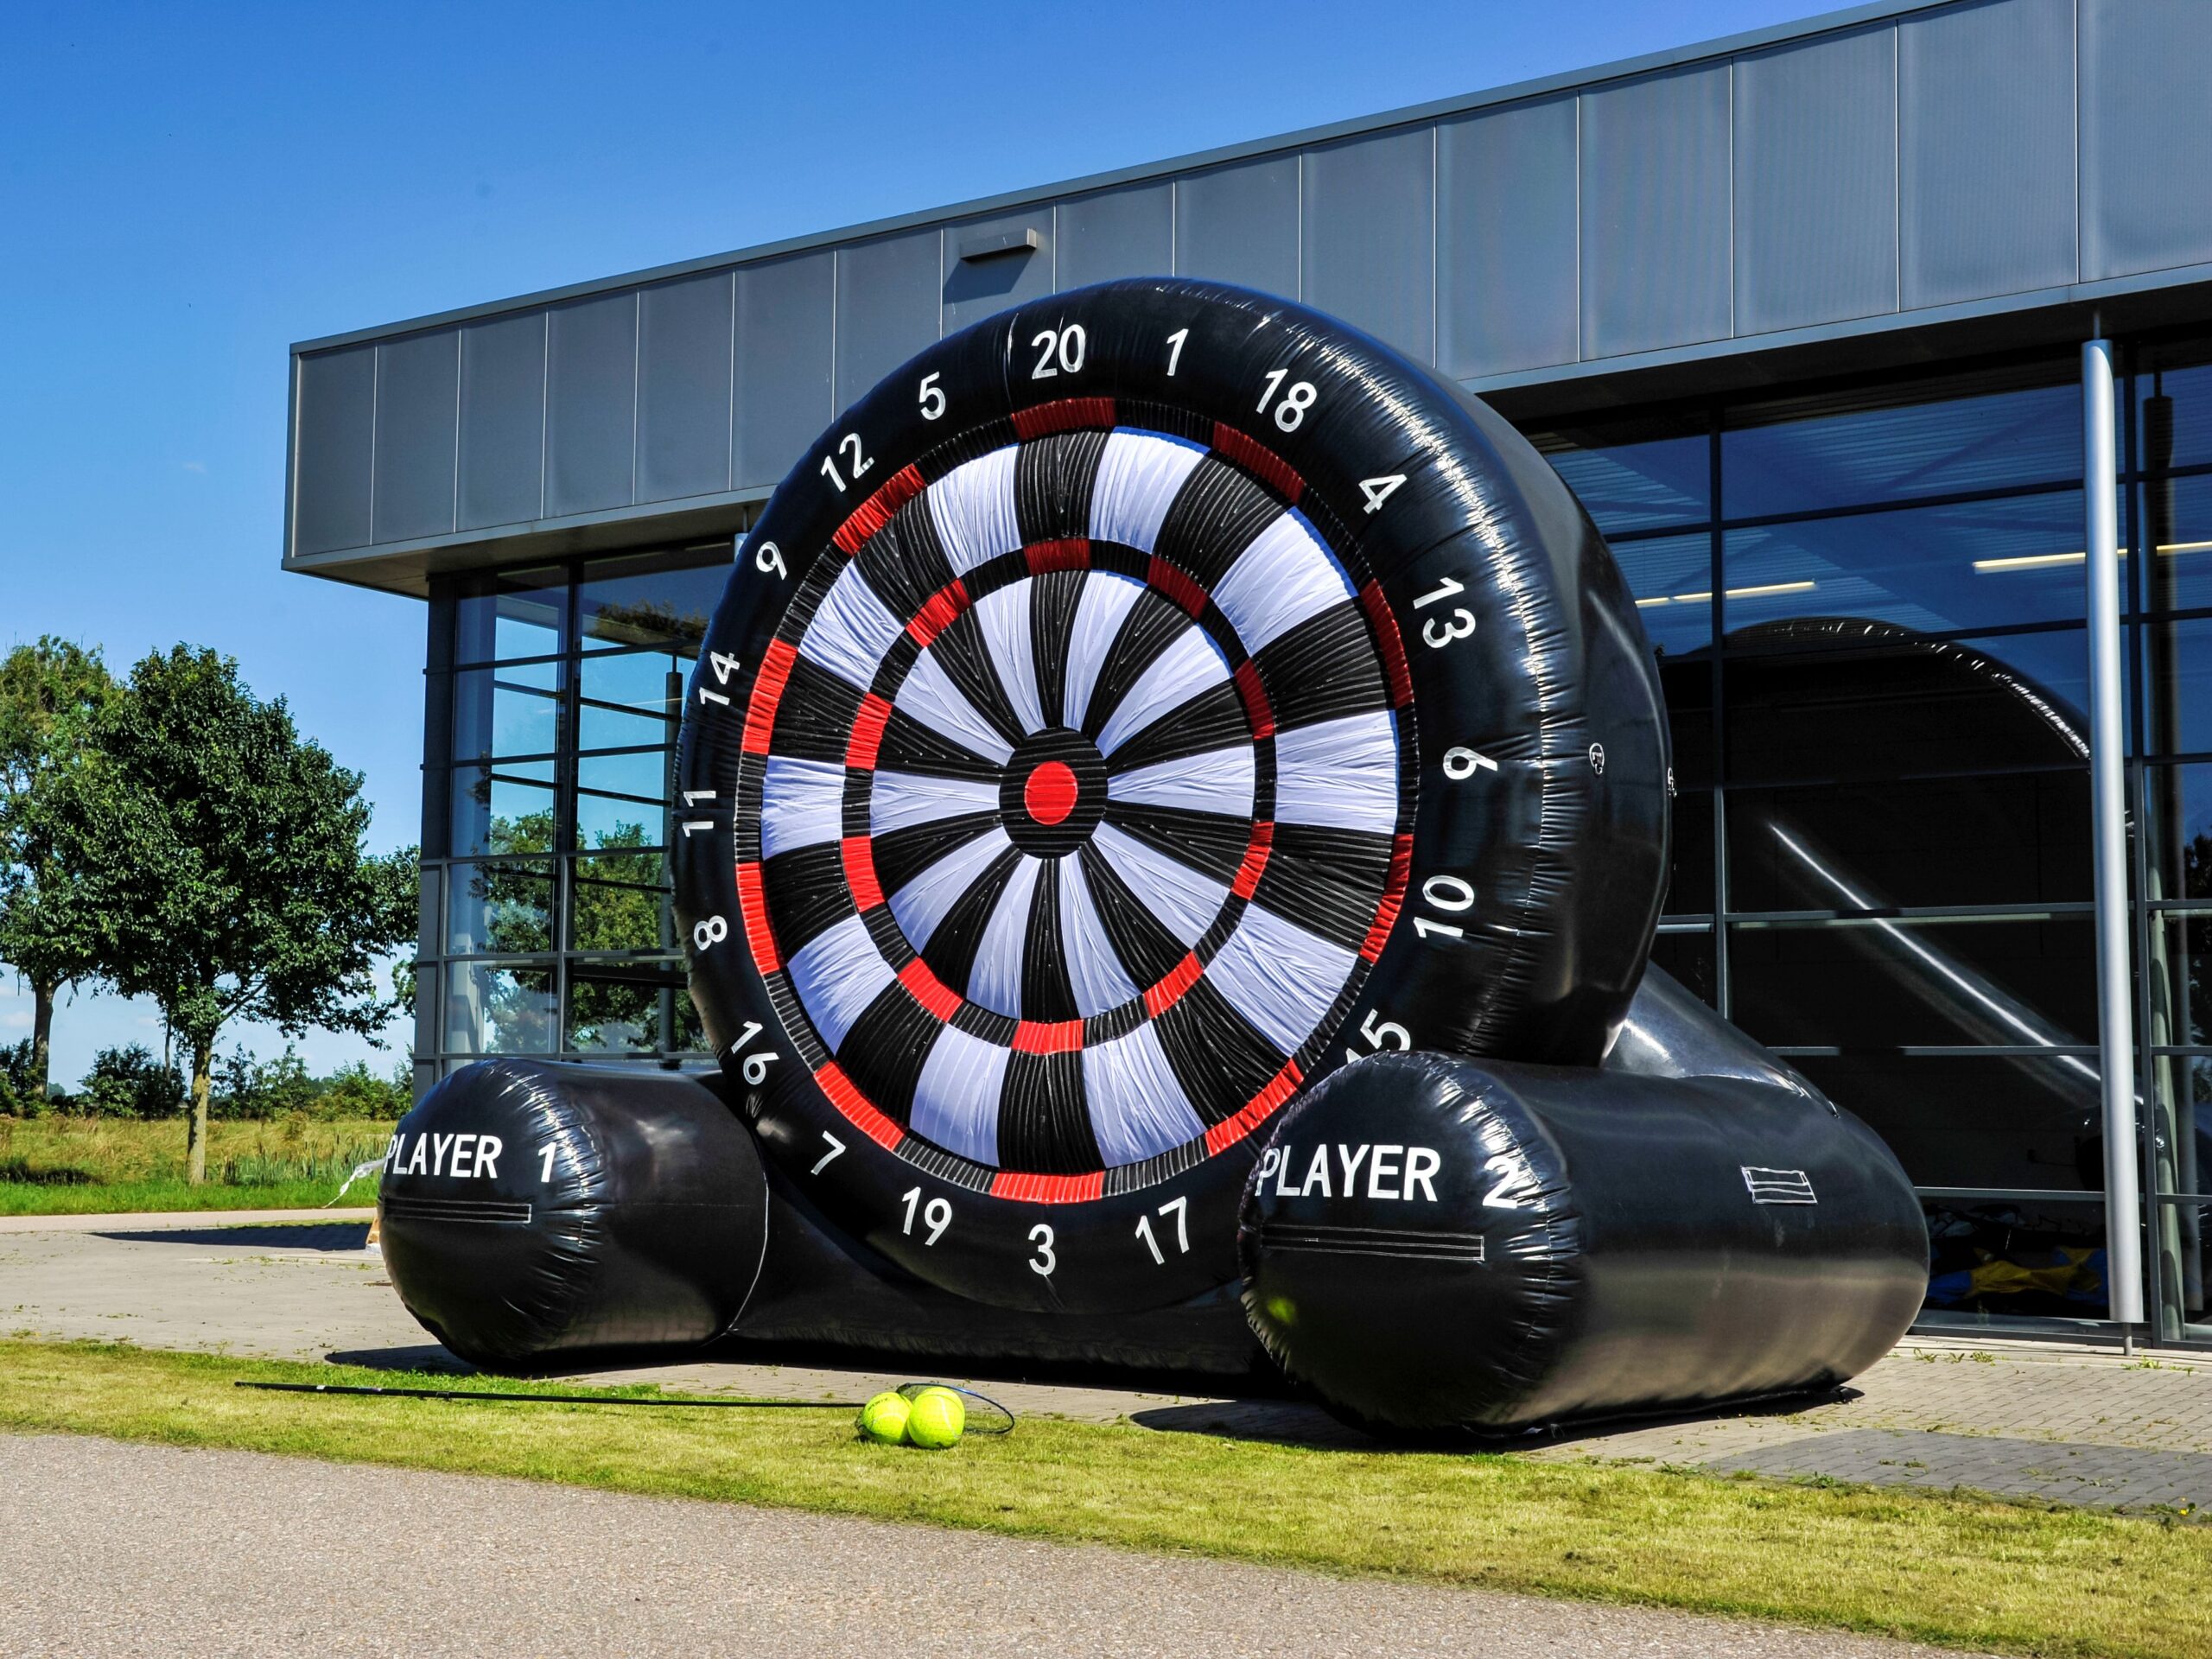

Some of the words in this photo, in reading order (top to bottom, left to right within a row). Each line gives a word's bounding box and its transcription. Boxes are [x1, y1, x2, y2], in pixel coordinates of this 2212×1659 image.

[1031, 324, 1086, 379] 20
[1166, 327, 1189, 377] 1
[918, 372, 946, 421] 5
[1255, 368, 1318, 433] 18
[820, 432, 874, 493] 12
[1358, 474, 1408, 514] 4
[755, 541, 788, 581] 9
[1413, 576, 1477, 649] 13
[698, 651, 741, 706] 14
[1442, 746, 1498, 780] 6
[682, 790, 717, 838] 11
[693, 915, 728, 951] 8
[1413, 874, 1475, 938] 10
[730, 1020, 779, 1085] 16
[382, 1132, 503, 1179] PLAYER
[537, 1141, 557, 1183] 1
[810, 1130, 847, 1176] 7
[1254, 1143, 1441, 1202] PLAYER
[1481, 1155, 1520, 1210] 2
[901, 1186, 953, 1246] 19
[1135, 1195, 1190, 1265] 17
[1027, 1224, 1056, 1279] 3
